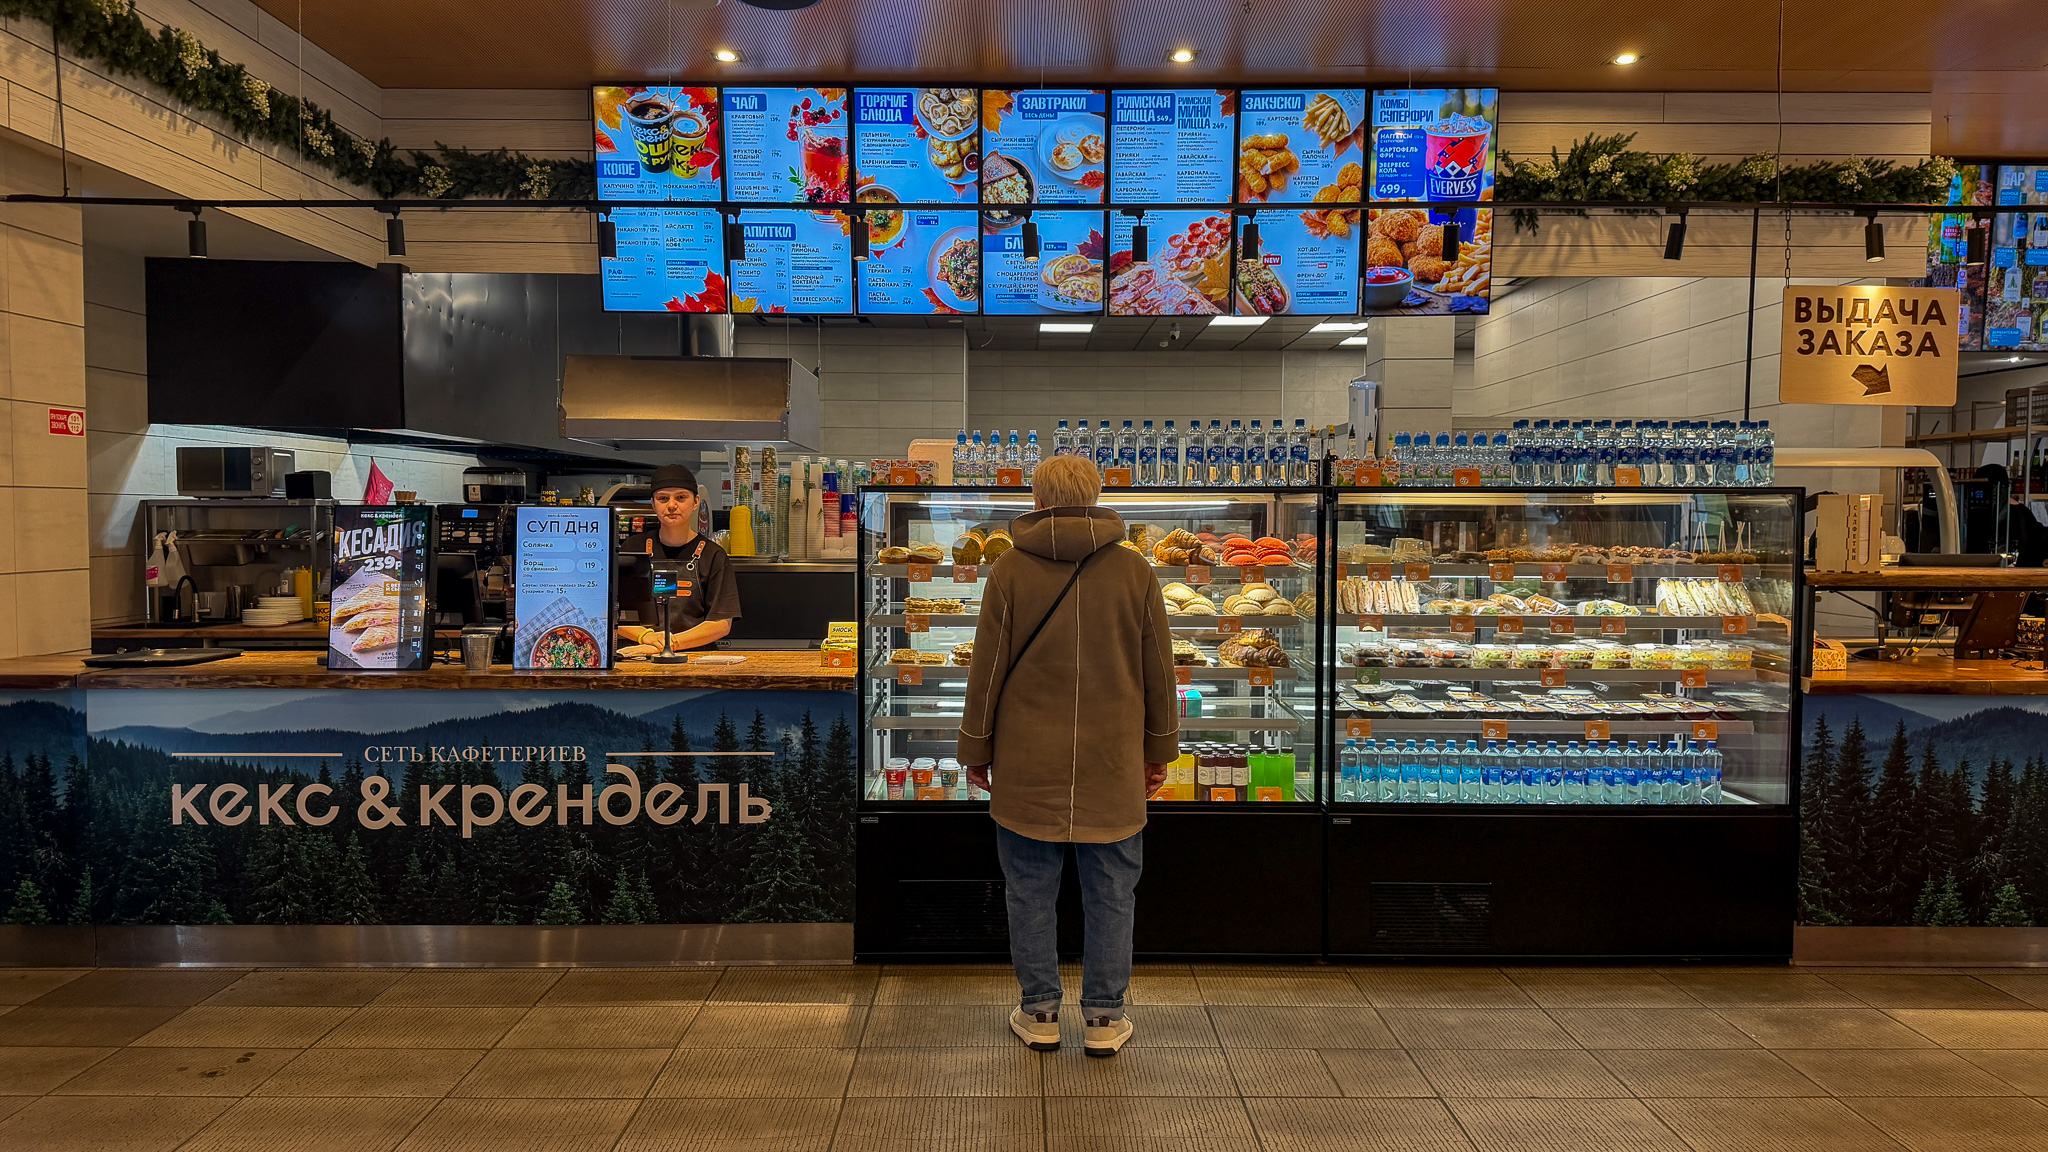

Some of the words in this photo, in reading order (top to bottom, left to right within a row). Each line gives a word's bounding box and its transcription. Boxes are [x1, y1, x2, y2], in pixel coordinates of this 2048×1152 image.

[731, 96, 758, 110] ЧАЙ
[860, 94, 908, 108] ГОРЯЧИЕ
[1022, 97, 1087, 110] ЗАВТРАКИ
[1116, 95, 1171, 109] РИМСКАЯ
[1178, 96, 1212, 105] РИМСКАЯ
[1245, 96, 1301, 110] ЗАКУСКИ
[1380, 98, 1409, 109] КОМБО
[860, 108, 903, 122] БЛЮДА
[1116, 109, 1156, 123] ПИЦЦА
[1178, 105, 1211, 118] МИНИ
[1380, 110, 1434, 123] СУПЕРФРИ
[1178, 118, 1211, 130] ПИЦЦА
[603, 163, 636, 176] КОФЕ
[1430, 177, 1477, 195] EVERVESS
[2003, 172, 2026, 186] БАР
[1379, 184, 1401, 194] 499
[744, 226, 792, 238] АПИТКИ
[1794, 296, 1947, 329] ВЫДАЧА
[1796, 329, 1942, 358] ЗАКАЗА
[526, 520, 560, 533] СУП
[564, 520, 599, 535] ДНЯ
[338, 521, 422, 559] КЕСАДИЯ
[363, 746, 425, 763] СЕТЬ
[429, 743, 587, 763] КАФЕТЕРИЕВ
[171, 782, 341, 827] кекс
[356, 774, 403, 828] &
[419, 763, 774, 839] крендель
